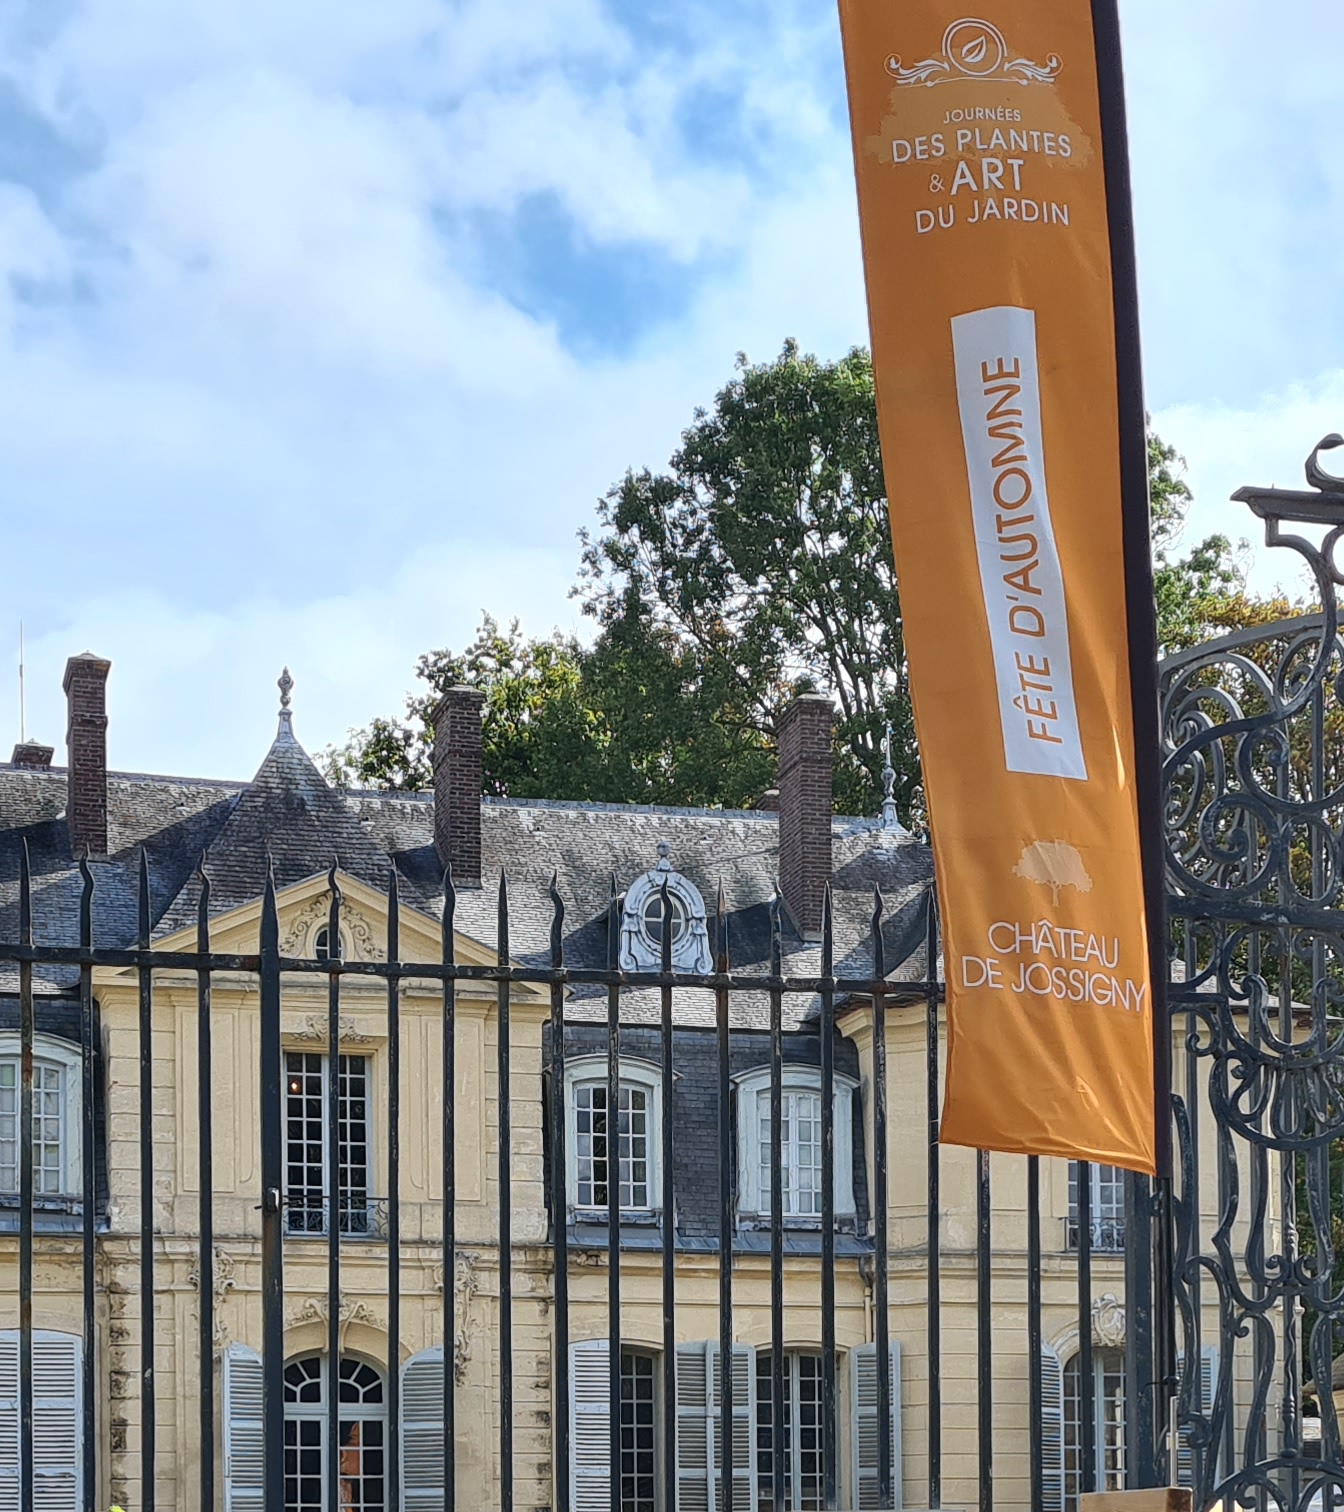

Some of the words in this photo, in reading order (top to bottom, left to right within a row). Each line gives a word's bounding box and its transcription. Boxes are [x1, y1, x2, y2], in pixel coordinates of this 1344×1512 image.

[943, 105, 1022, 124] JOURNÉES
[892, 134, 945, 163] DES
[955, 128, 1073, 158] PLANTES
[929, 174, 945, 193] &
[950, 158, 1024, 195] ART
[915, 204, 955, 234] DU
[967, 197, 1070, 226] JARDIN
[980, 356, 1046, 638] D'AUTOMNE
[1013, 651, 1063, 744] FÊTE
[988, 919, 1119, 969] CHÂTEAU
[961, 955, 1003, 989] DE
[1011, 962, 1147, 1012] JOSSIGNY
